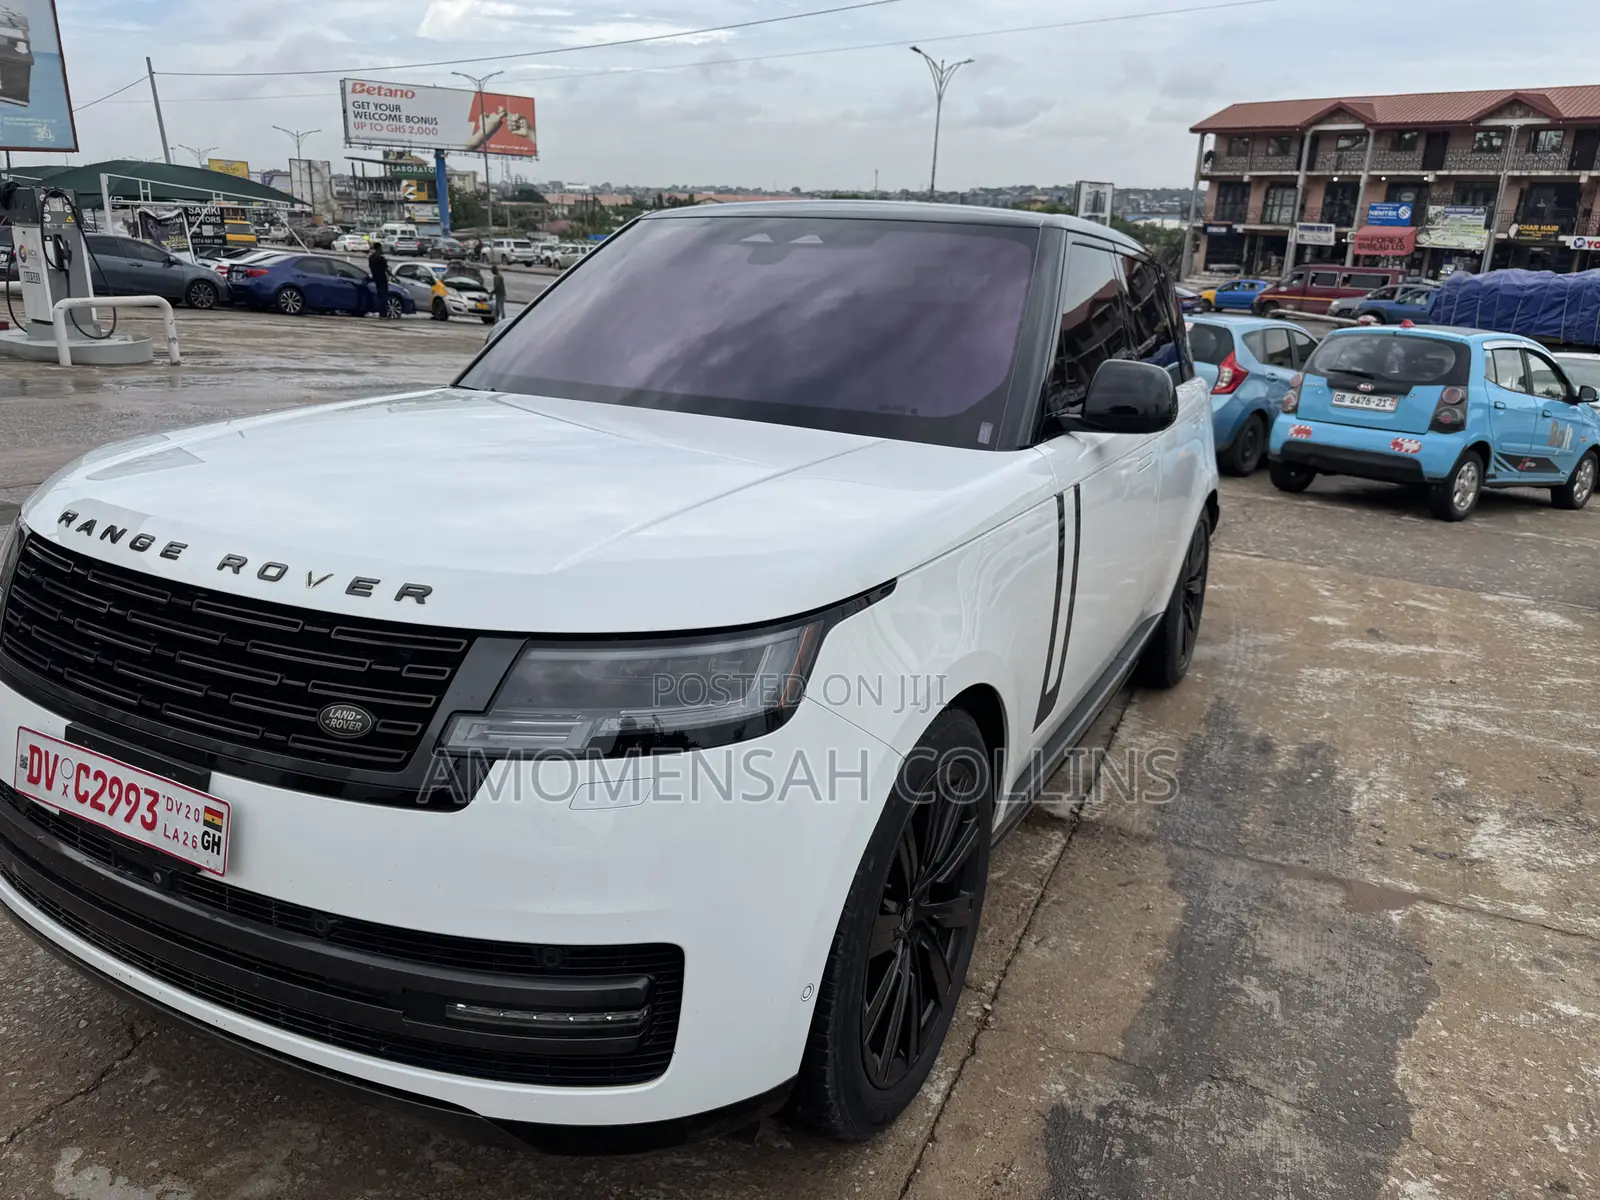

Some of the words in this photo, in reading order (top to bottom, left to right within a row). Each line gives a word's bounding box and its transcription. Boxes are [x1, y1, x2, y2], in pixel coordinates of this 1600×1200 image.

[351, 82, 416, 99] Betano
[352, 100, 371, 110] GET
[373, 102, 402, 112] YOUR
[353, 110, 403, 123] WELCOME
[405, 115, 439, 126] BONUS
[353, 121, 366, 130] UP
[369, 123, 383, 132] TO
[386, 124, 407, 134] GHS
[408, 125, 438, 136] 2,000
[391, 165, 437, 174] LABORATO
[188, 215, 221, 224] MOTORS
[1391, 243, 1405, 251] LTD
[57, 509, 188, 561] RANGE
[216, 553, 433, 605] ROVER
[329, 708, 356, 721] LAND
[329, 717, 362, 732] ROVER
[27, 743, 60, 791] DV
[74, 762, 160, 832] C2993
[201, 830, 222, 857] GH
